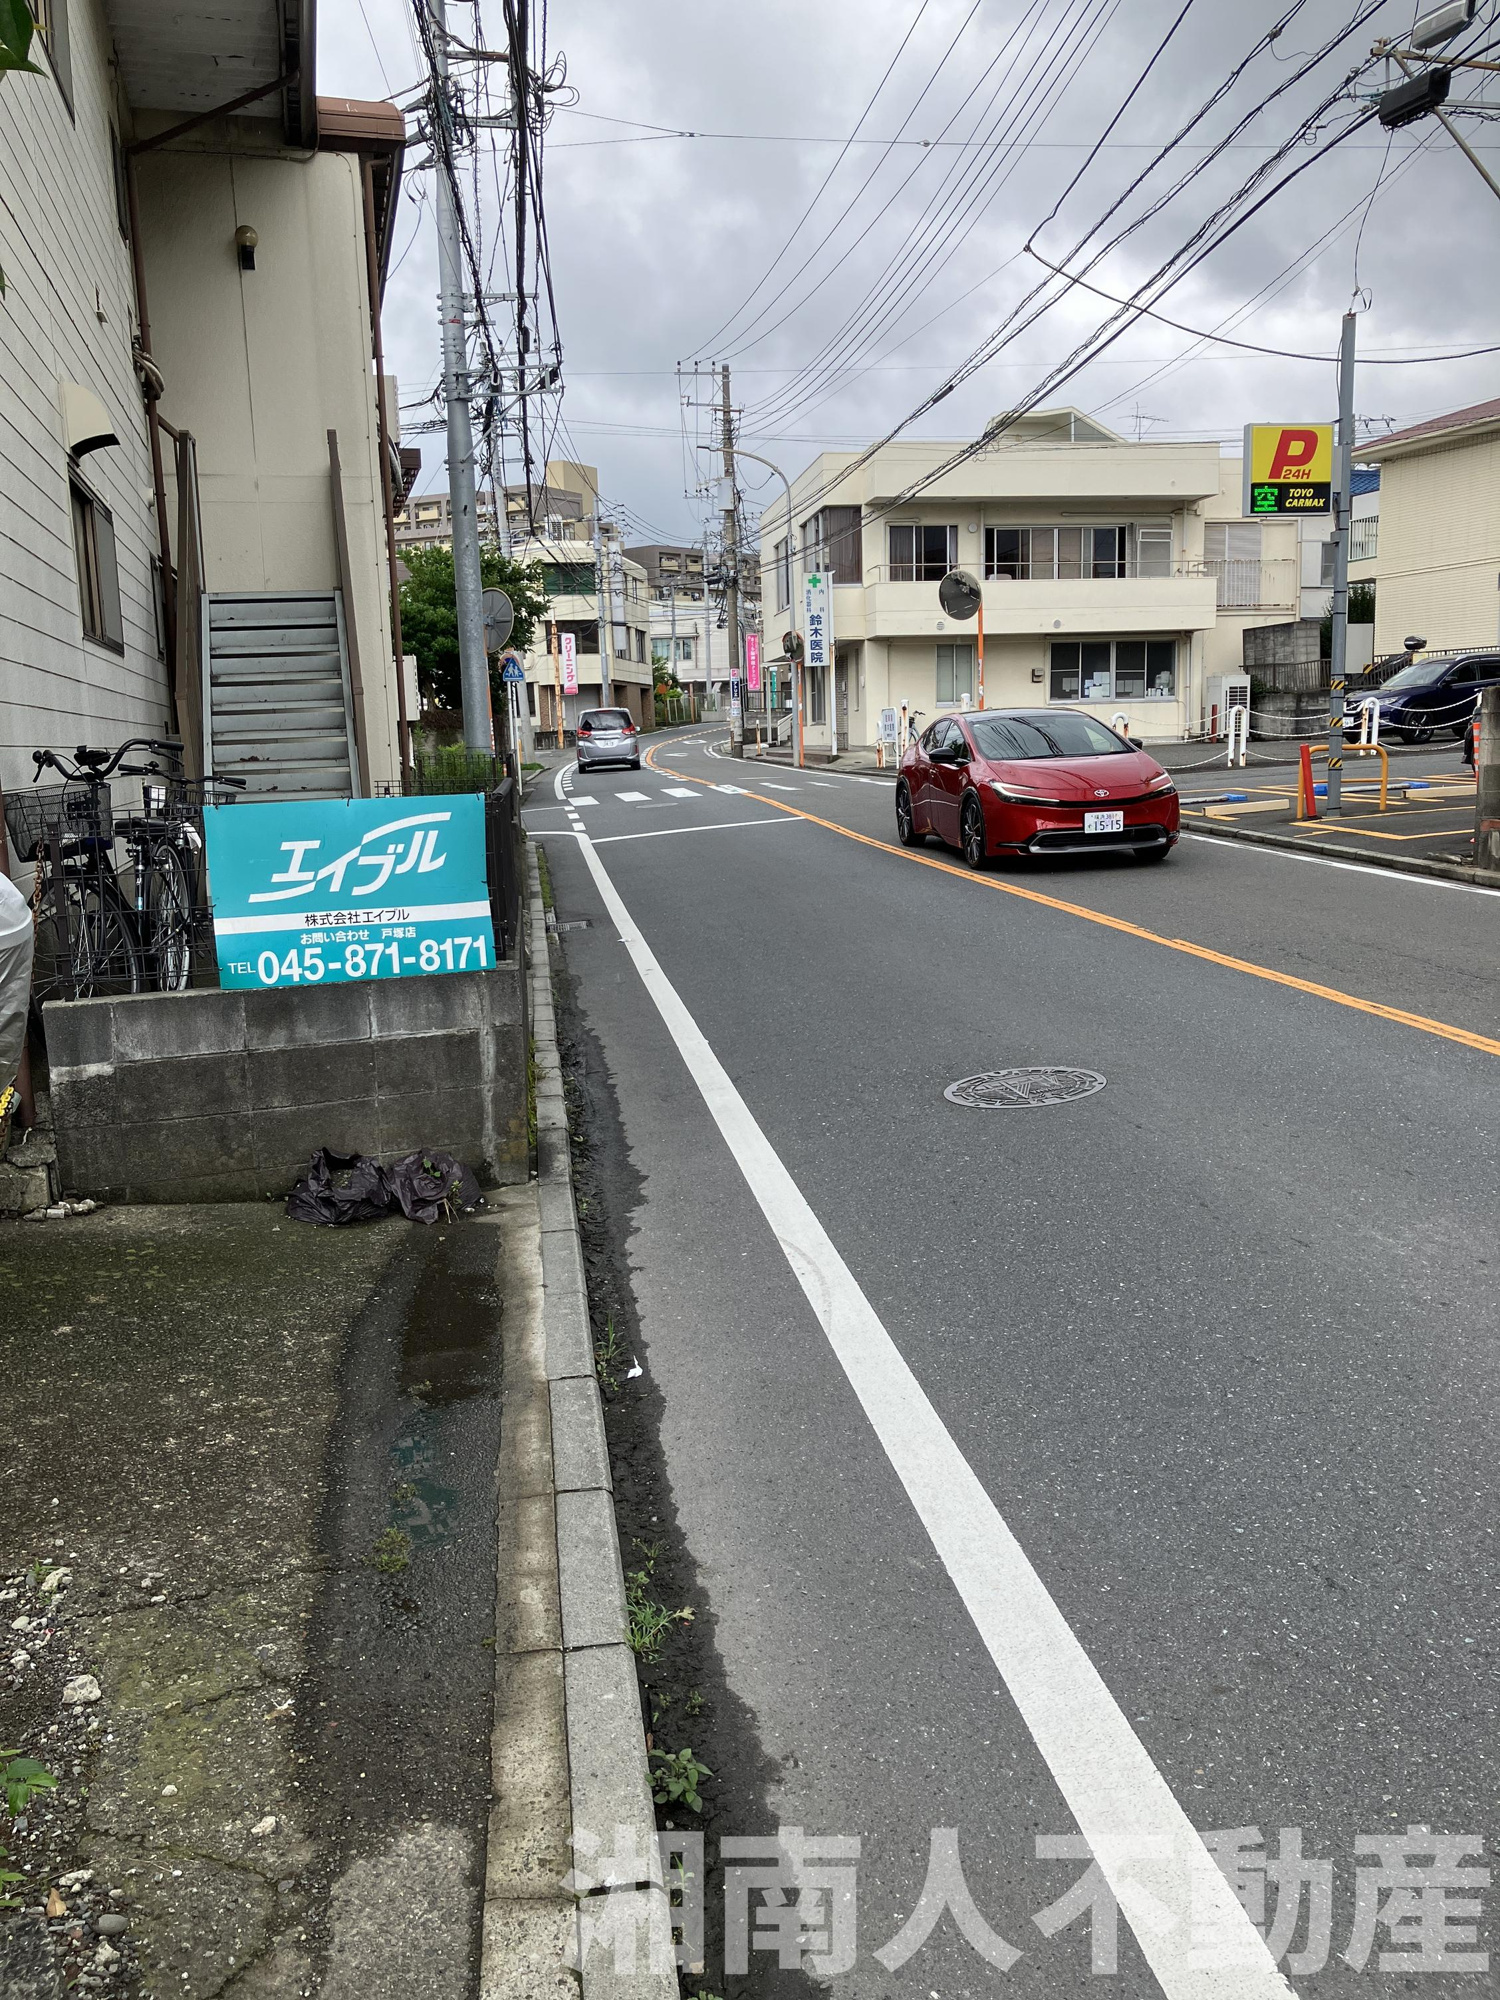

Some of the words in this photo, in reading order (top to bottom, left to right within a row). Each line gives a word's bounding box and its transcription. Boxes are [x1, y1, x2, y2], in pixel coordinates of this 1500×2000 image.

[1268, 429, 1319, 480] P
[1282, 469, 1312, 480] 24H
[1254, 485, 1278, 512] 空
[1285, 498, 1326, 507] CARMAX
[1289, 488, 1314, 497] TOYO
[809, 614, 824, 663] 鈴木医院
[564, 637, 576, 683] クリーニング
[1094, 820, 1121, 831] 15-15
[248, 811, 452, 903] エイブル
[304, 908, 410, 927] 株式会社エイブル
[300, 929, 370, 945] お問い合わせ
[381, 926, 417, 939] 戸塚店
[227, 961, 256, 975] TEL
[257, 935, 488, 985] 045-871-8171
